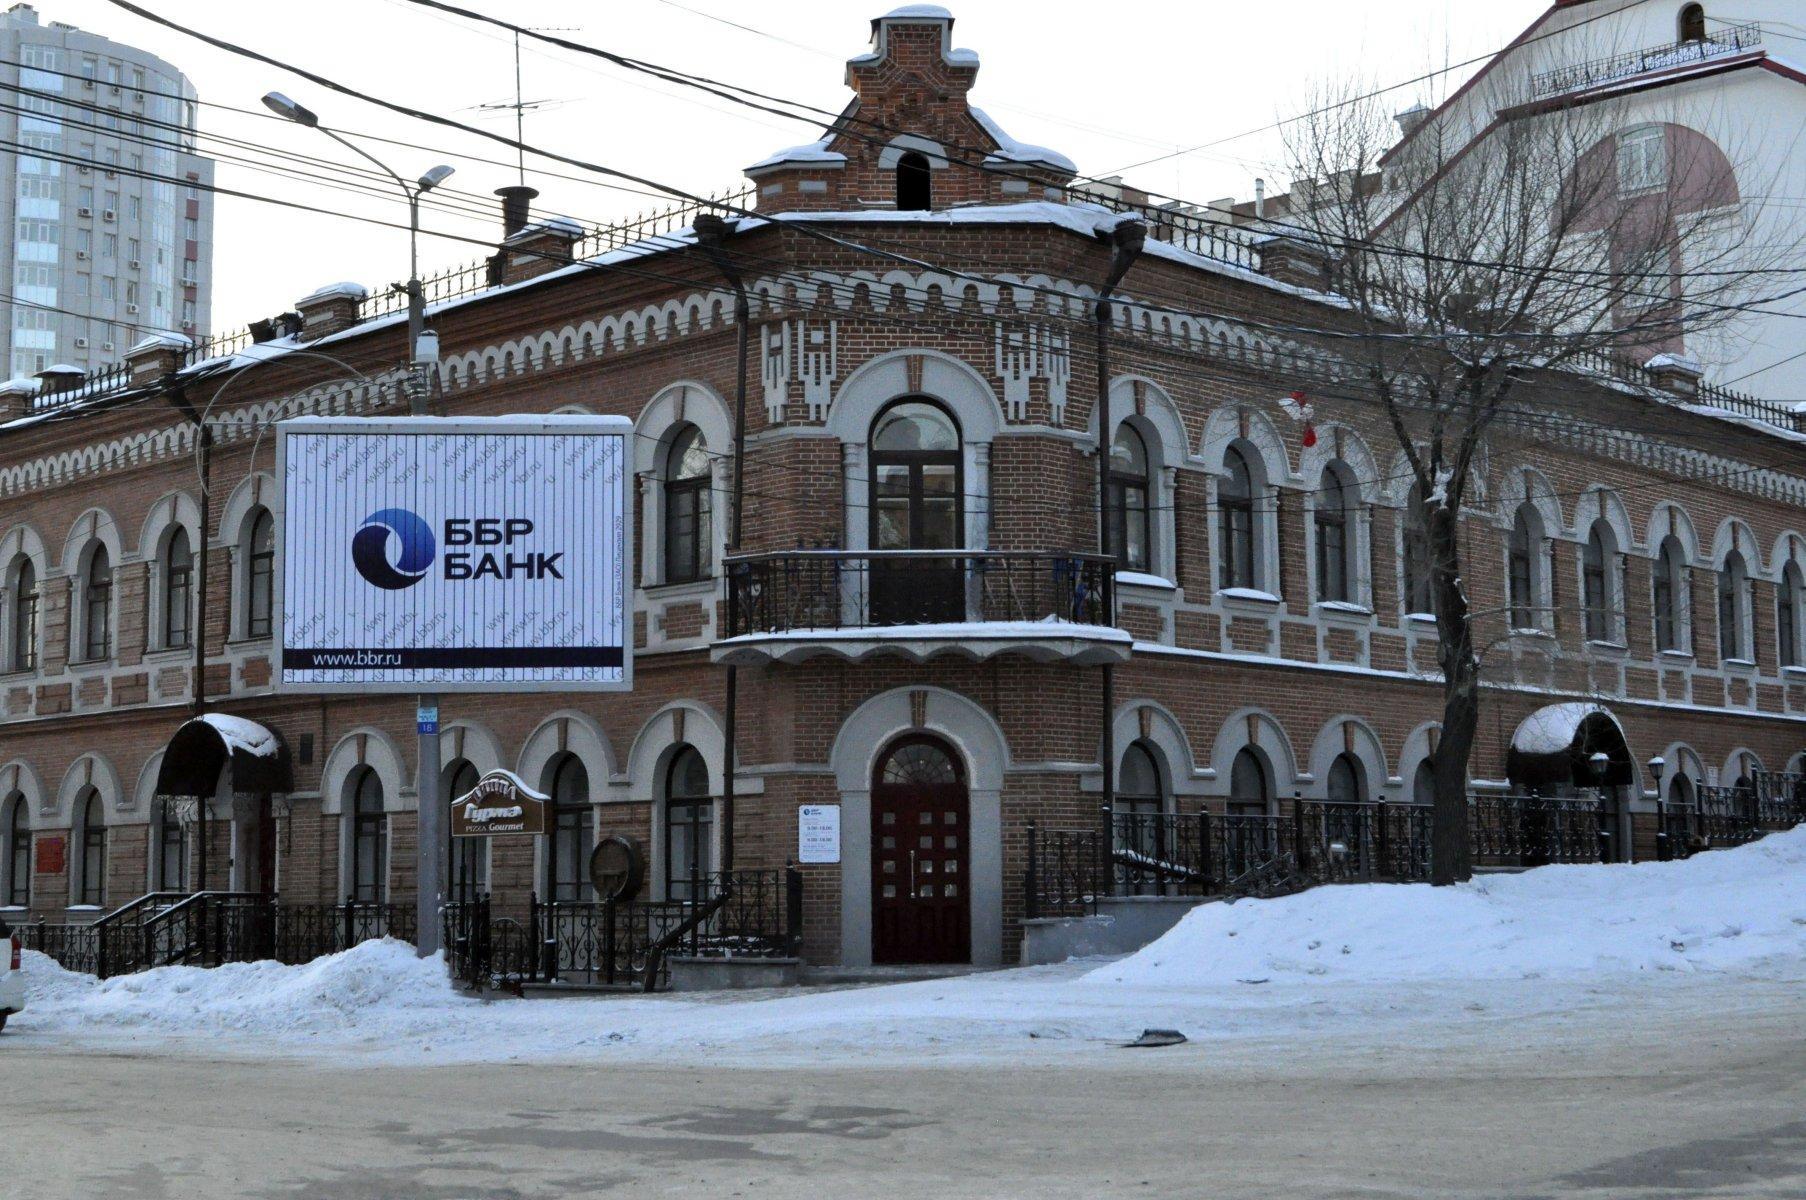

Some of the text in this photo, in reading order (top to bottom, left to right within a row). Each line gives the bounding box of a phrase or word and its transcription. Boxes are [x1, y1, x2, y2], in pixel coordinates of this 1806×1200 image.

[445, 519, 534, 545] ББР
[445, 553, 564, 579] БАНК
[313, 650, 402, 666] www.bbr.ru
[488, 822, 524, 831] Gourmet
